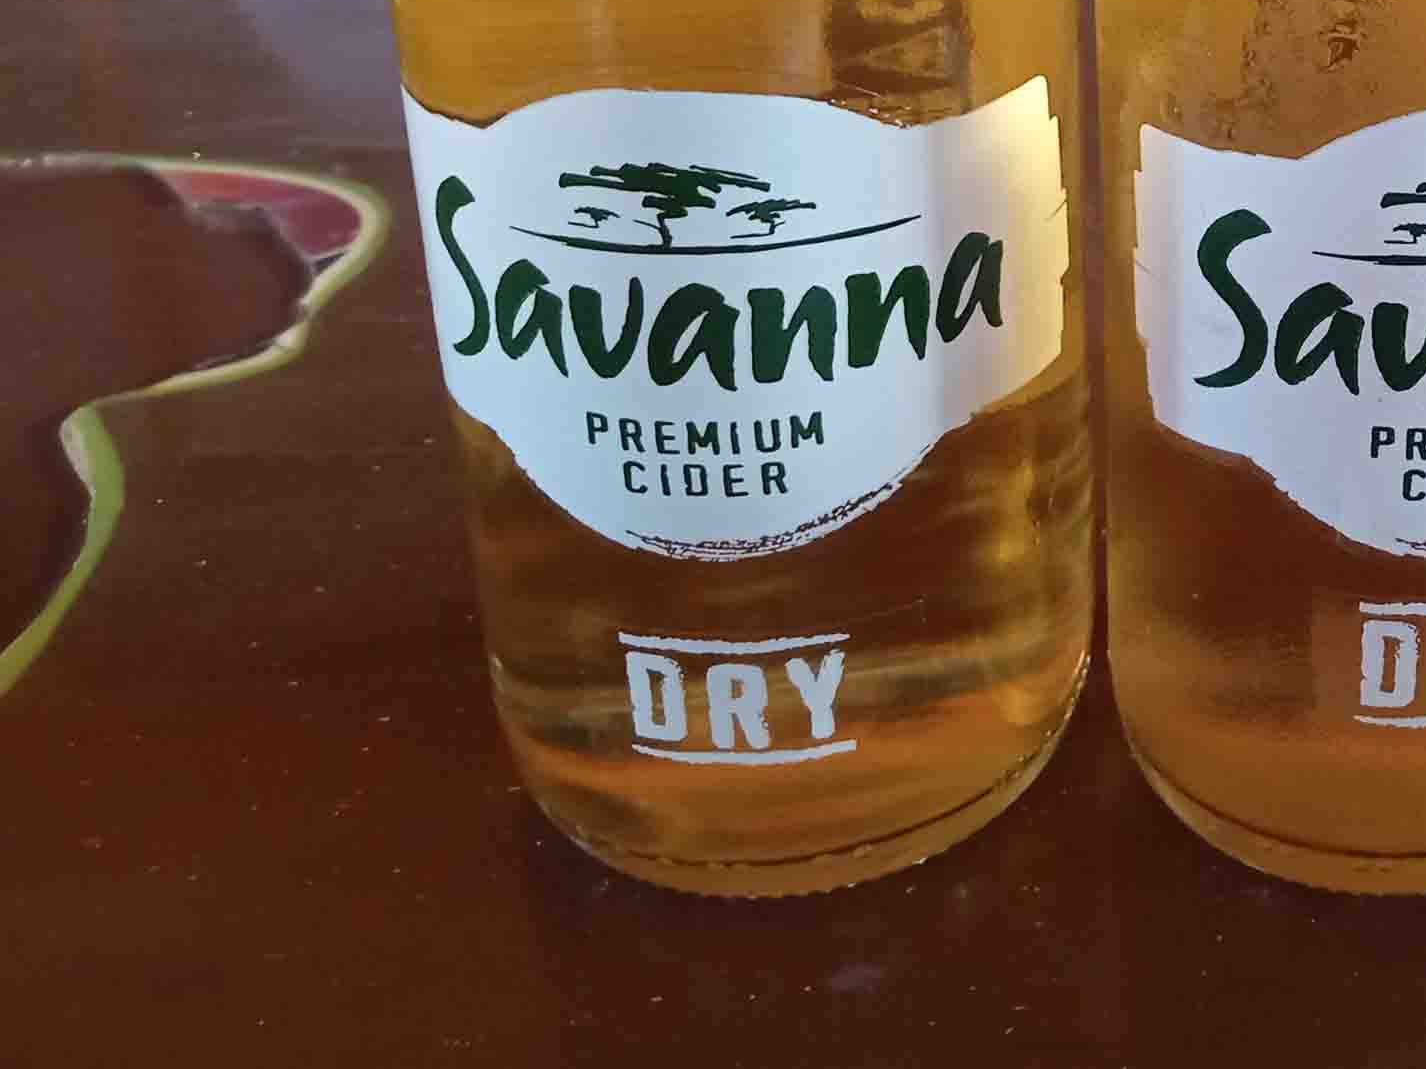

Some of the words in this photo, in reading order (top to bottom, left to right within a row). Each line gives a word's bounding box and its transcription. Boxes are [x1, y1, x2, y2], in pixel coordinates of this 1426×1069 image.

[436, 176, 1004, 391] Savanna
[586, 411, 825, 456] PREMIUM
[622, 461, 789, 497] CIDER
[625, 649, 846, 750] DRY
